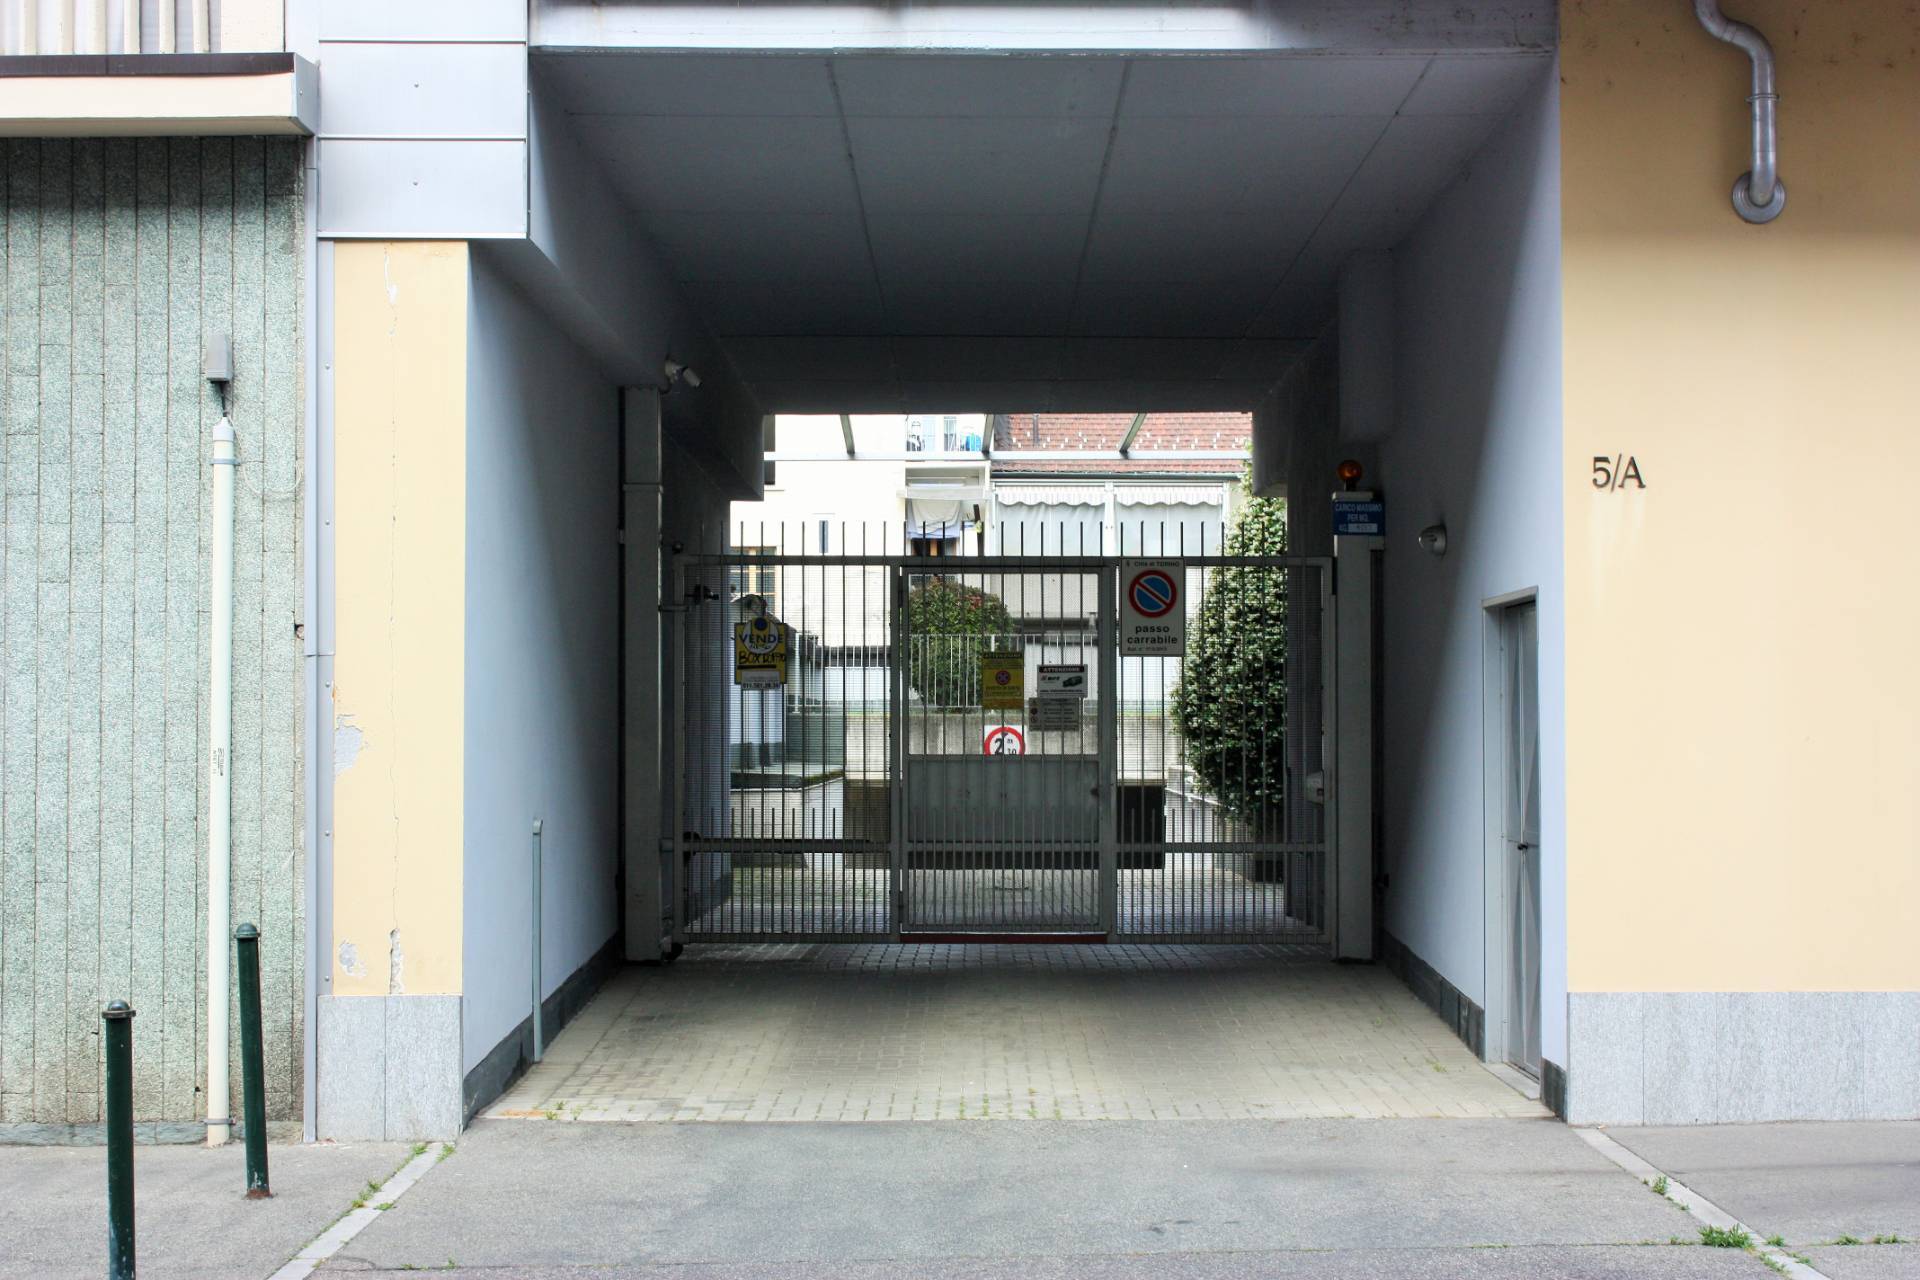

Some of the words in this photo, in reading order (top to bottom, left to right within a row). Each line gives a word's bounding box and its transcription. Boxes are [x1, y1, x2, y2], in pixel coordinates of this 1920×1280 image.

[1592, 453, 1646, 493] 5/A
[1335, 503, 1356, 512] CARICO
[1135, 625, 1170, 634] passo
[739, 633, 784, 644] VENDE
[1127, 635, 1178, 644] carrabile
